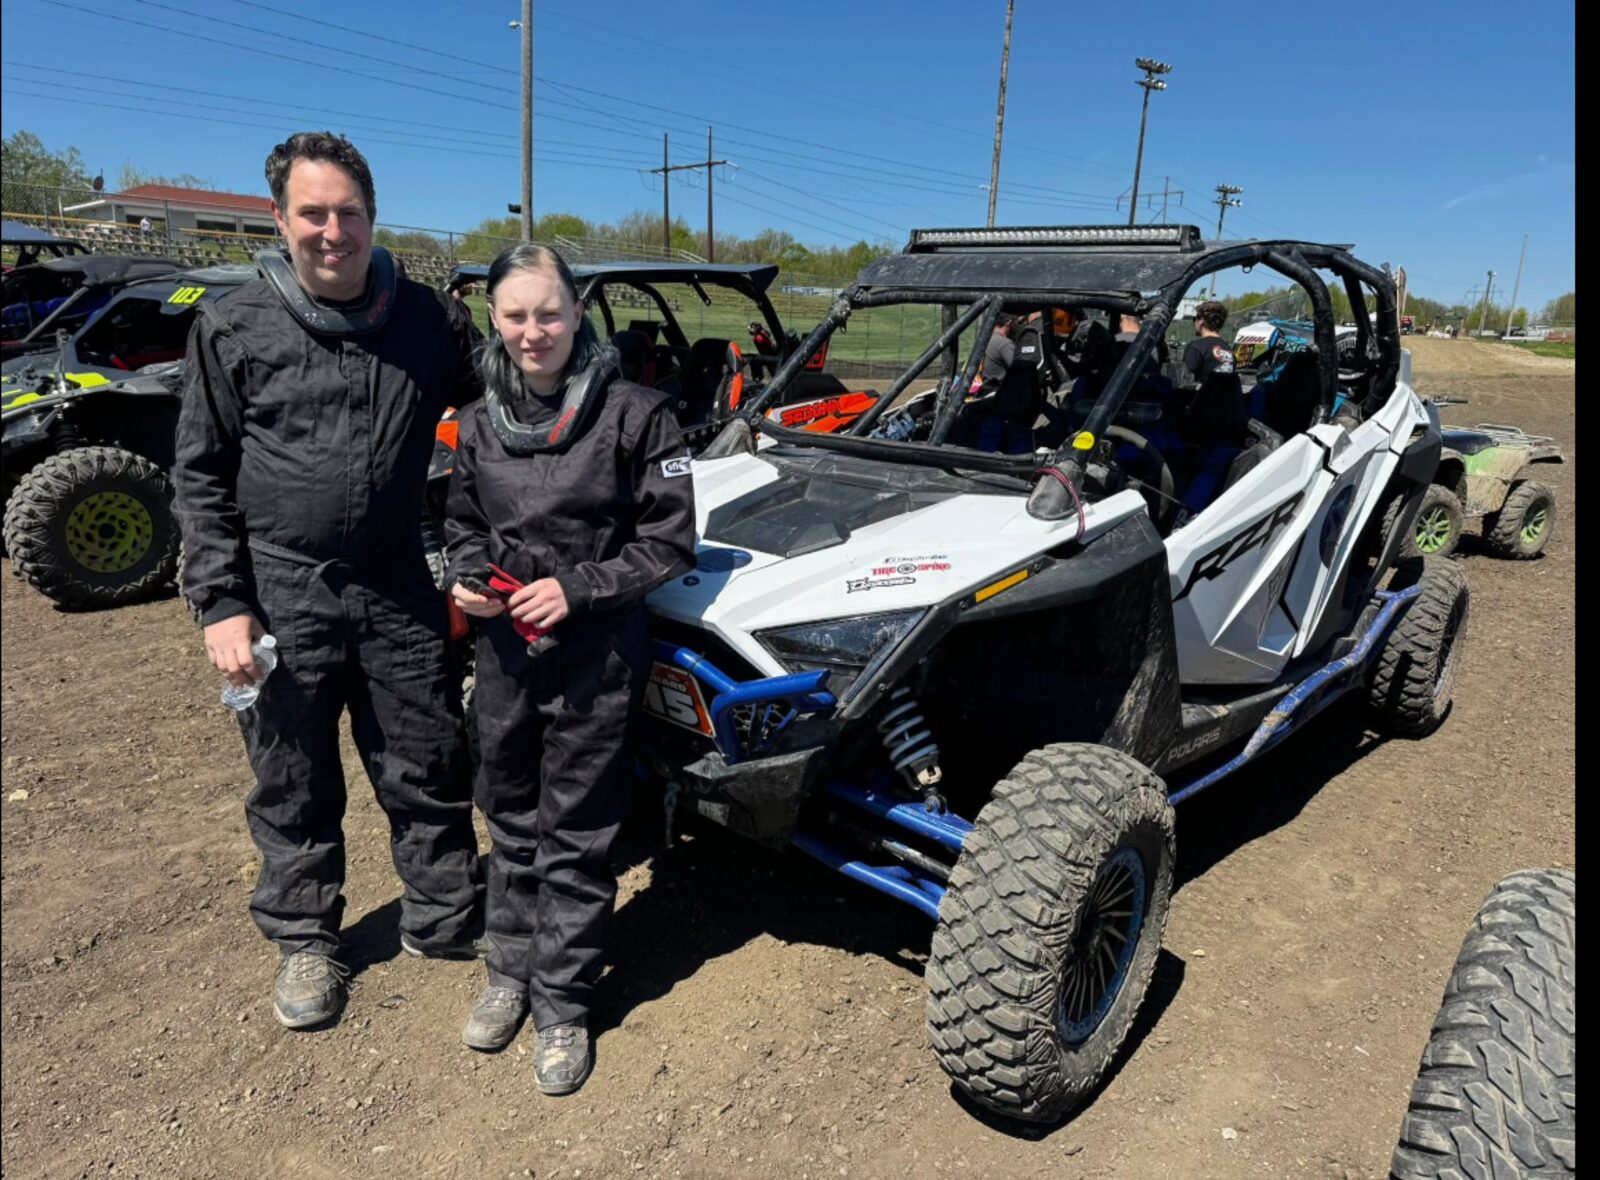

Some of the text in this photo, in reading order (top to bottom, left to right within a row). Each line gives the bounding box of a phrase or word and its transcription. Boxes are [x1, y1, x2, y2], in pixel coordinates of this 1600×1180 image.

[167, 286, 206, 304] 103
[1172, 489, 1305, 602] RZR
[1167, 726, 1221, 763] POLARIS
